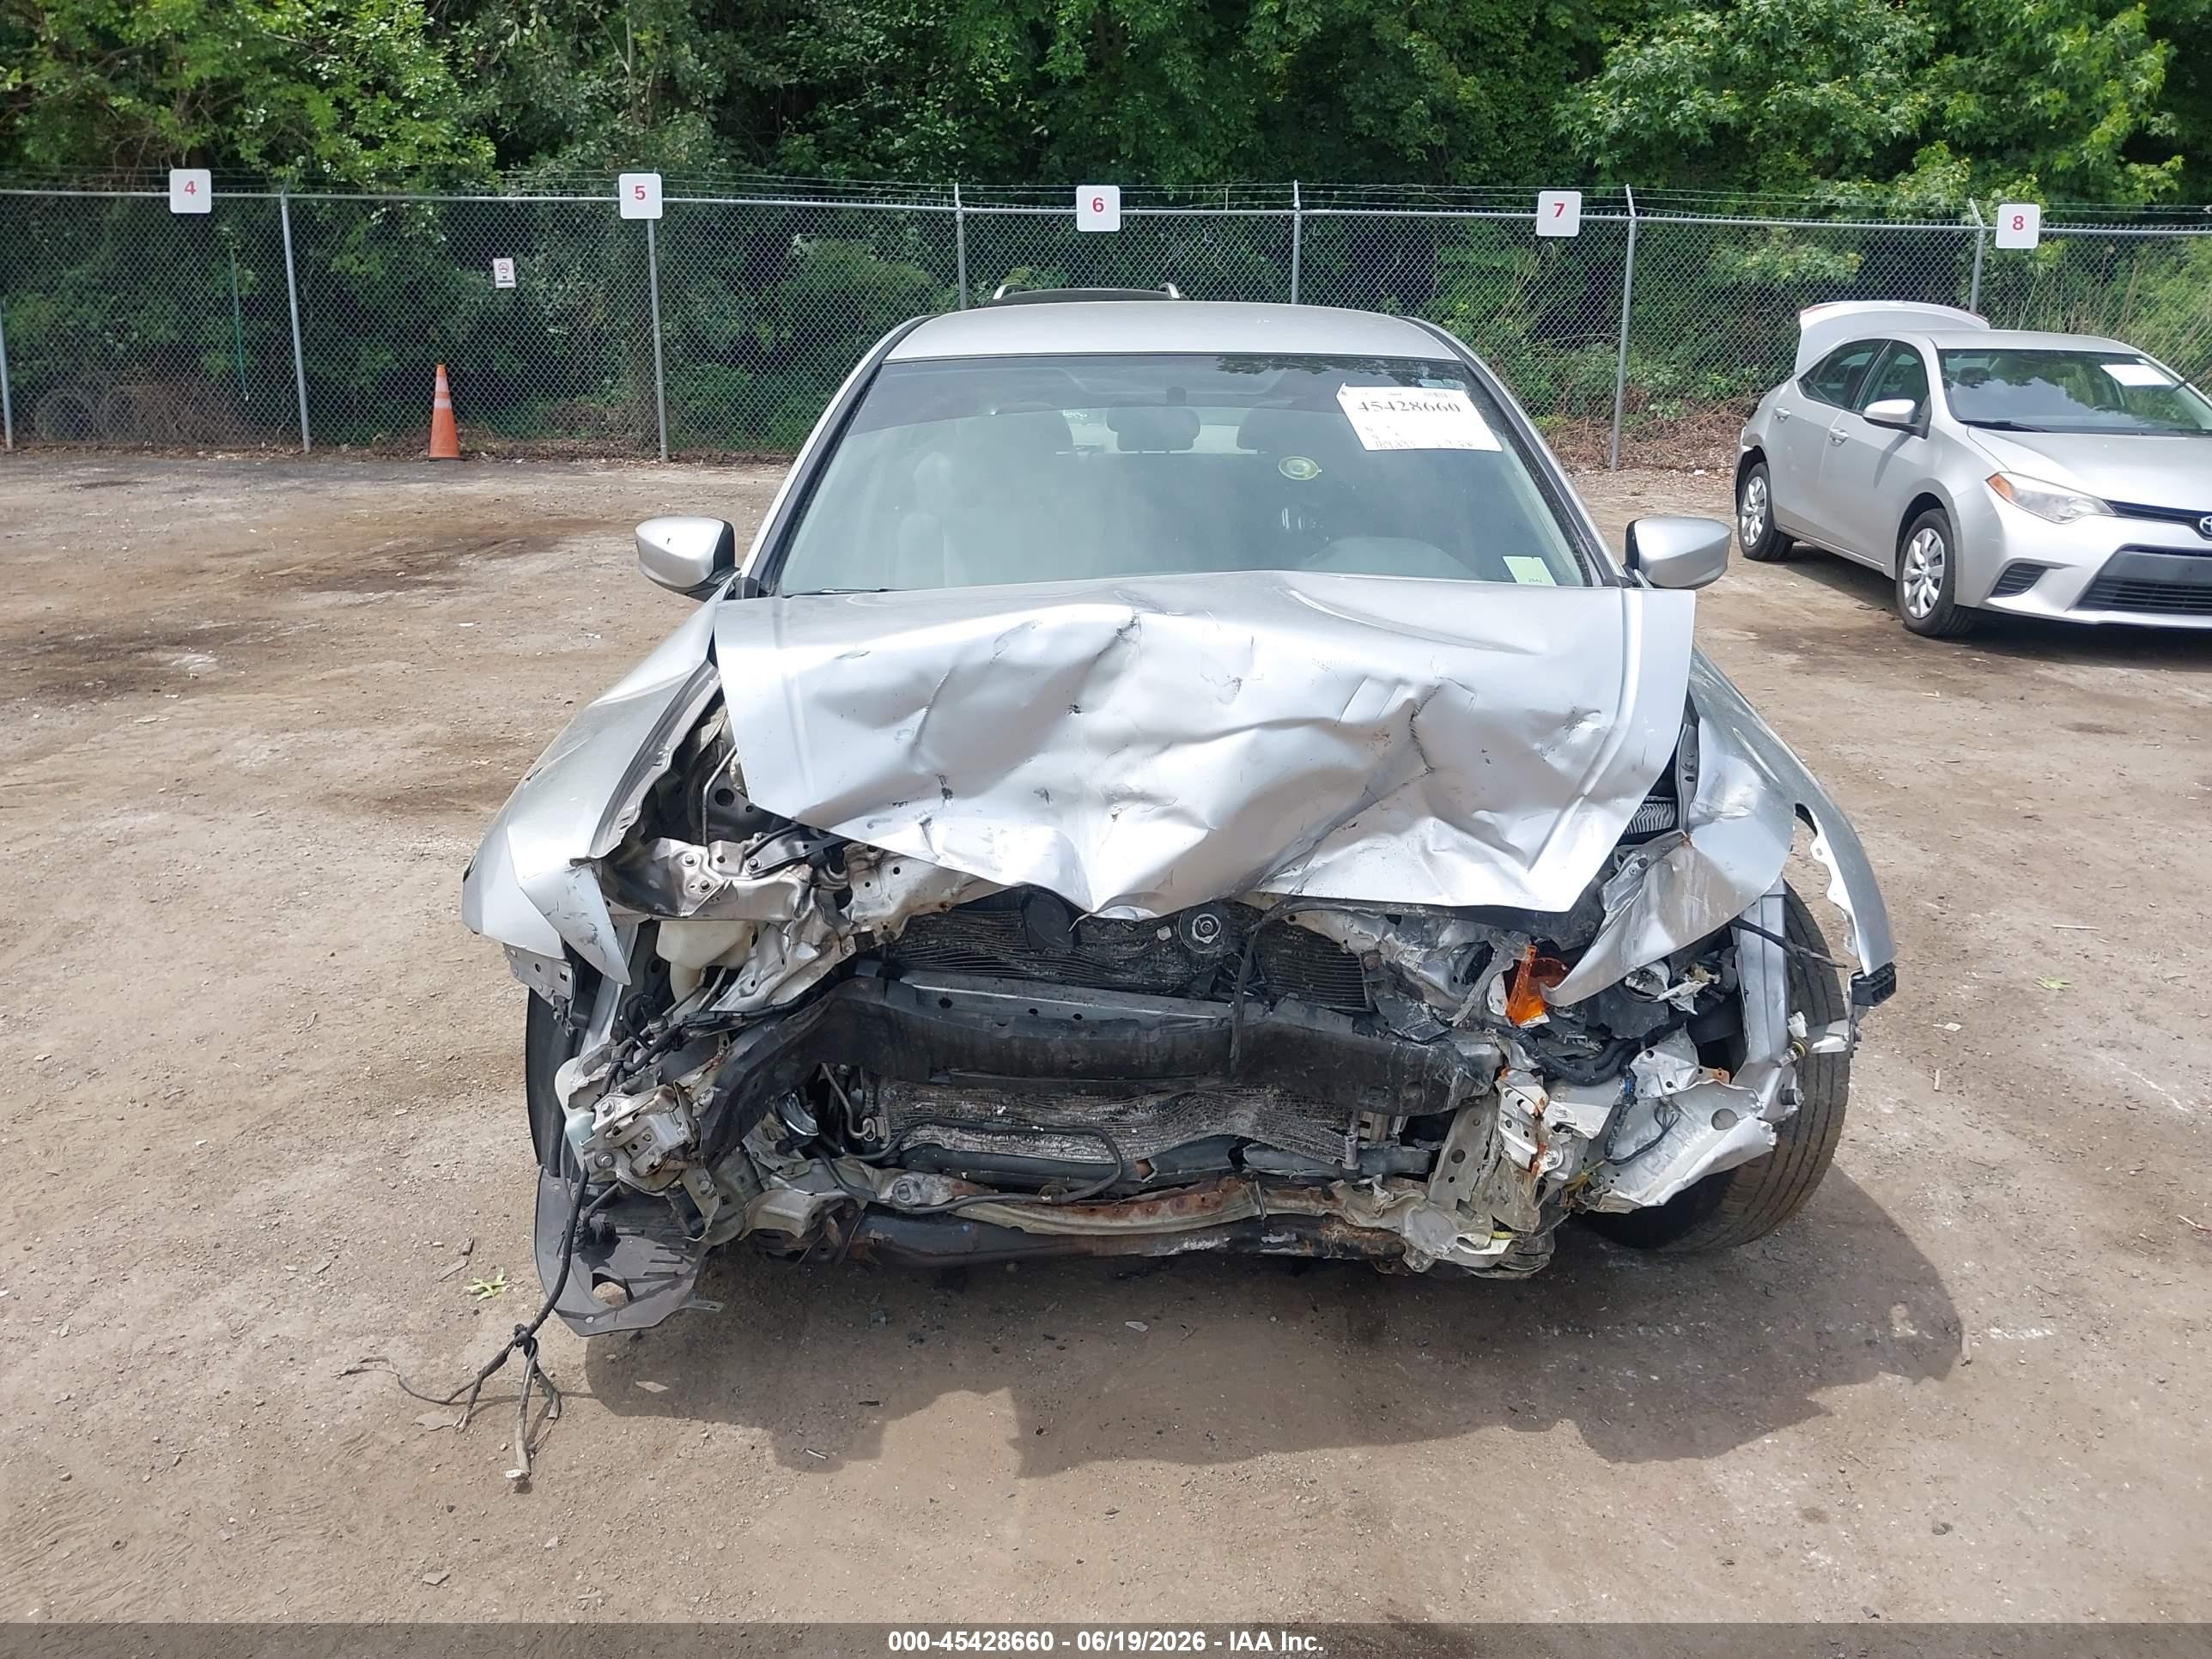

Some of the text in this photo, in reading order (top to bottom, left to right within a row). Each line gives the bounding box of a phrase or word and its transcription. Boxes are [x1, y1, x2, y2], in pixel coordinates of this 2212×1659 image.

[185, 181, 197, 195] 4
[634, 185, 646, 200] 5
[1091, 198, 1104, 212] 6
[1553, 202, 1565, 217] 7
[2012, 215, 2025, 231] 8
[1358, 401, 1461, 412] 45428660
